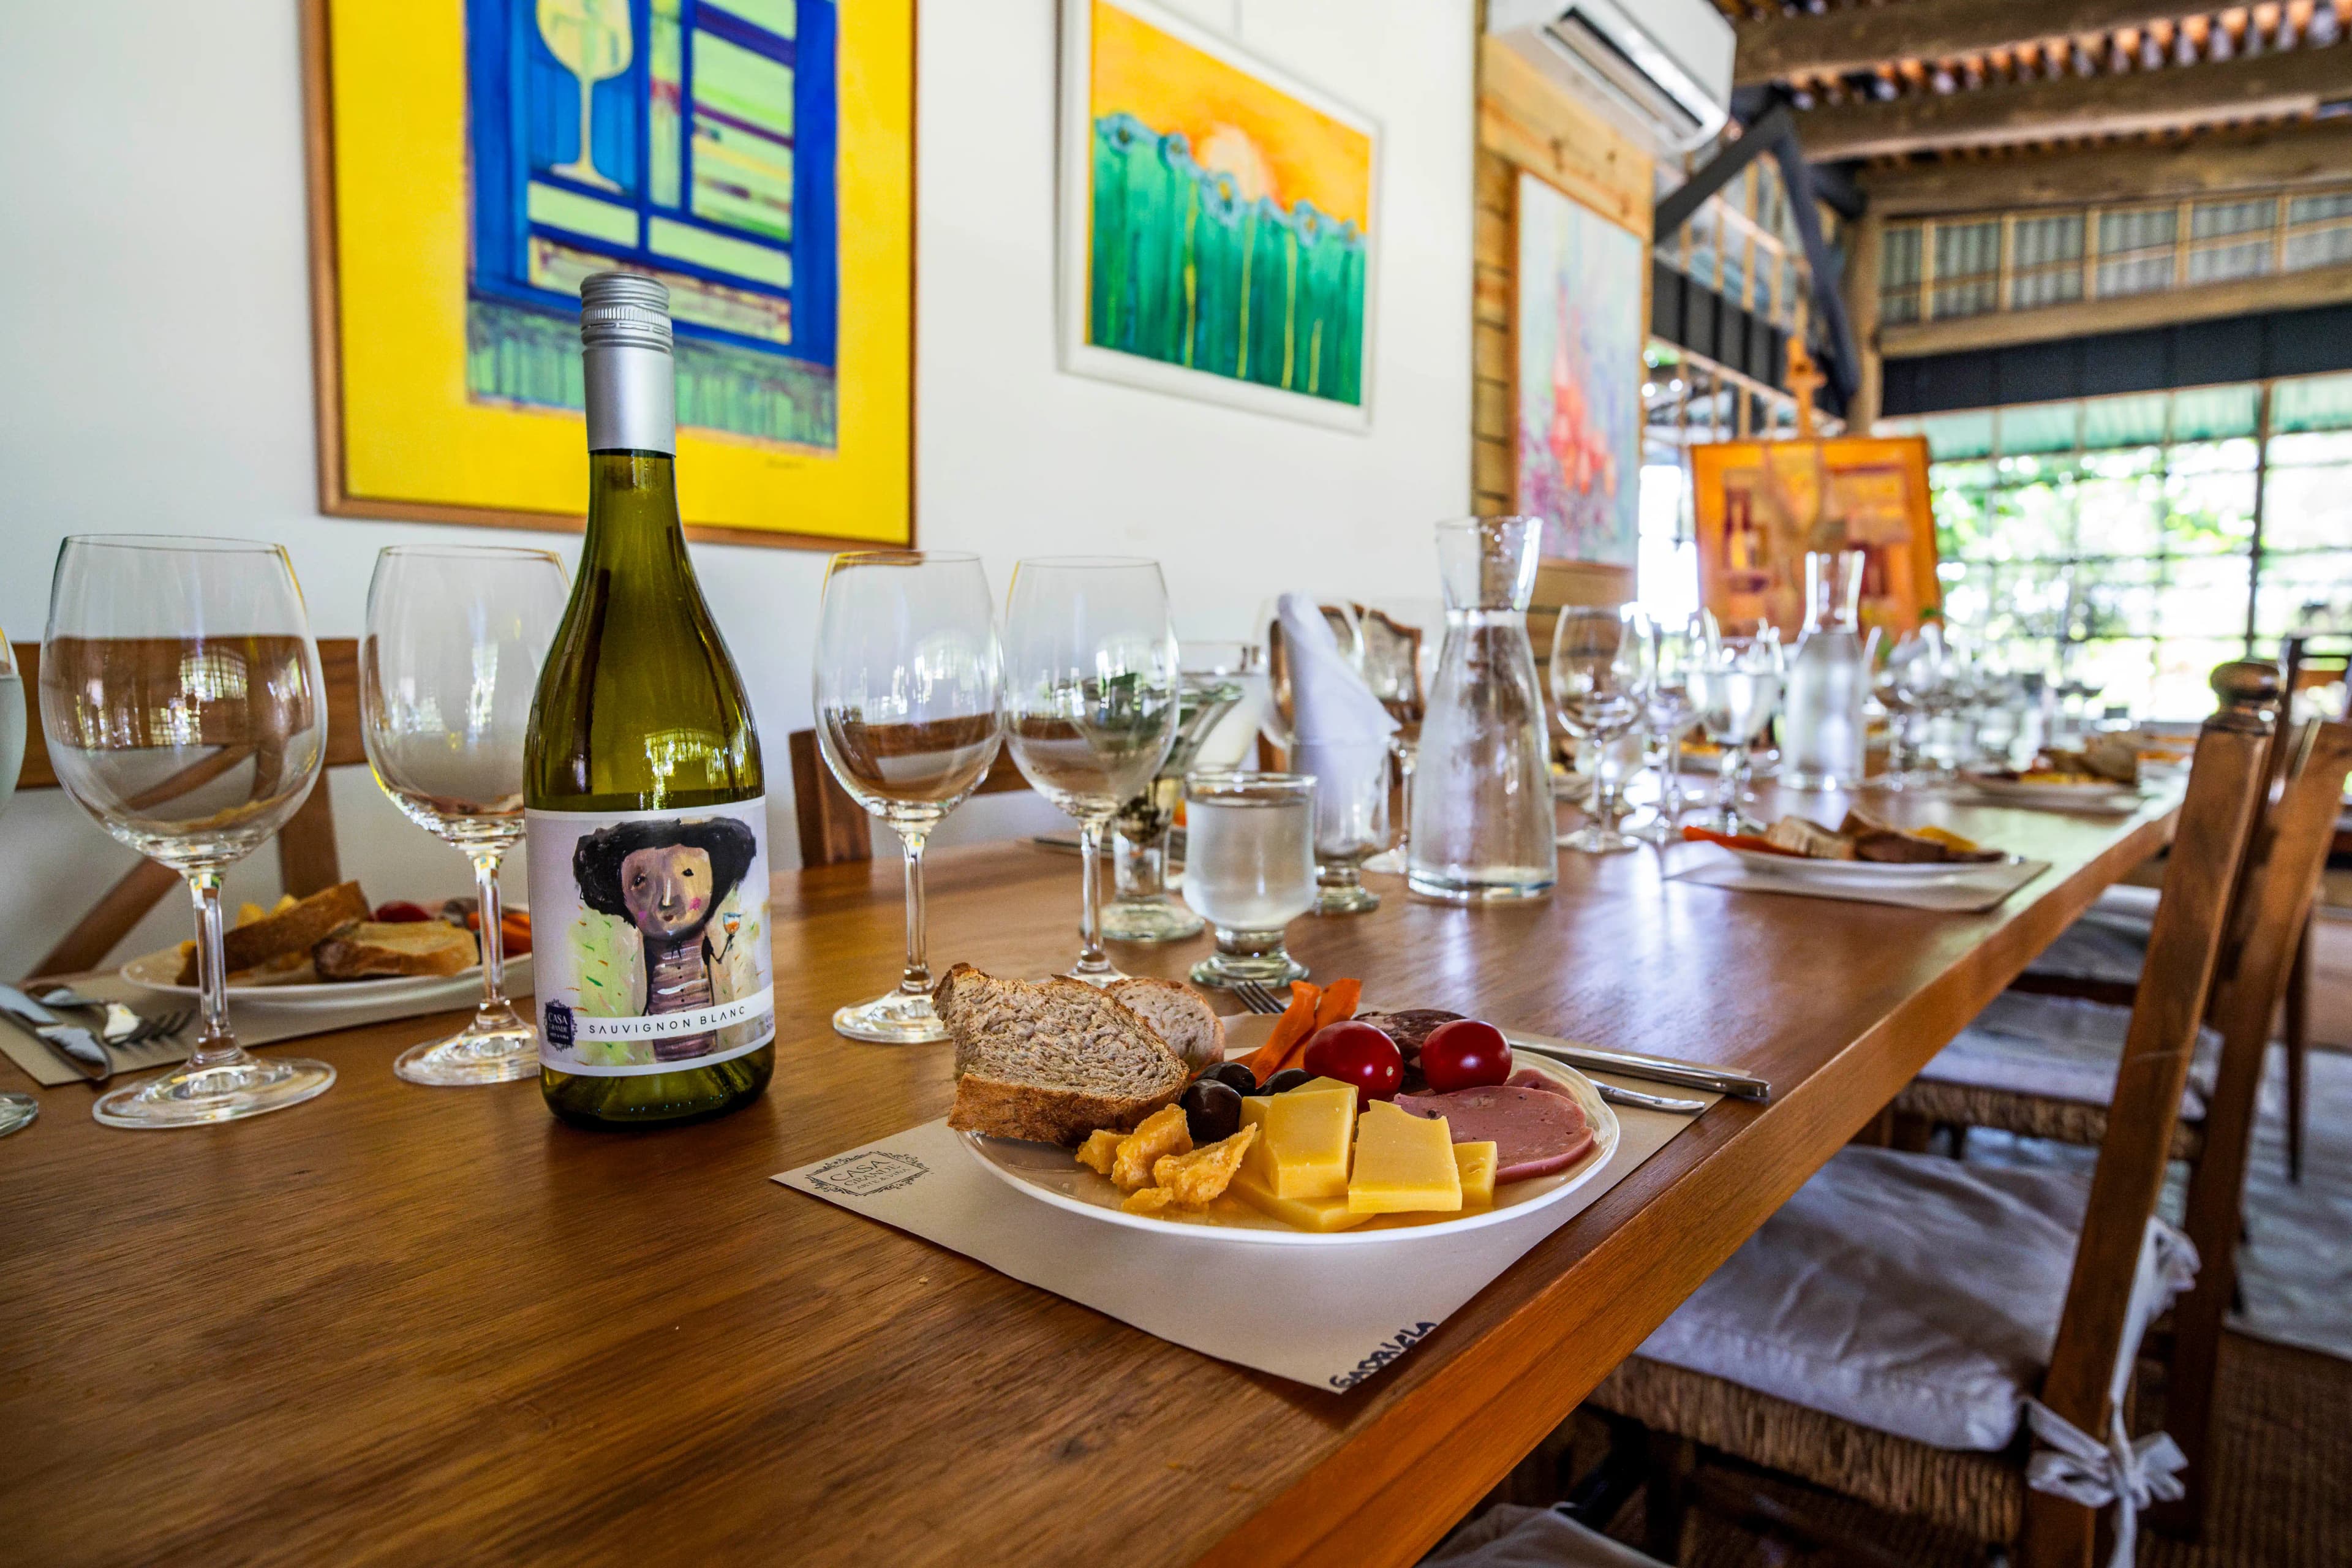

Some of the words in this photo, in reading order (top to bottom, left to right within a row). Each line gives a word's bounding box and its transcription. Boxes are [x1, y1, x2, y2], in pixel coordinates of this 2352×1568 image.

[548, 1012, 568, 1026] CASA
[589, 1019, 691, 1035] SAUVIGNON
[700, 1006, 745, 1025] BLANC
[830, 1161, 891, 1181] CASA
[844, 1164, 900, 1186] GRANDE
